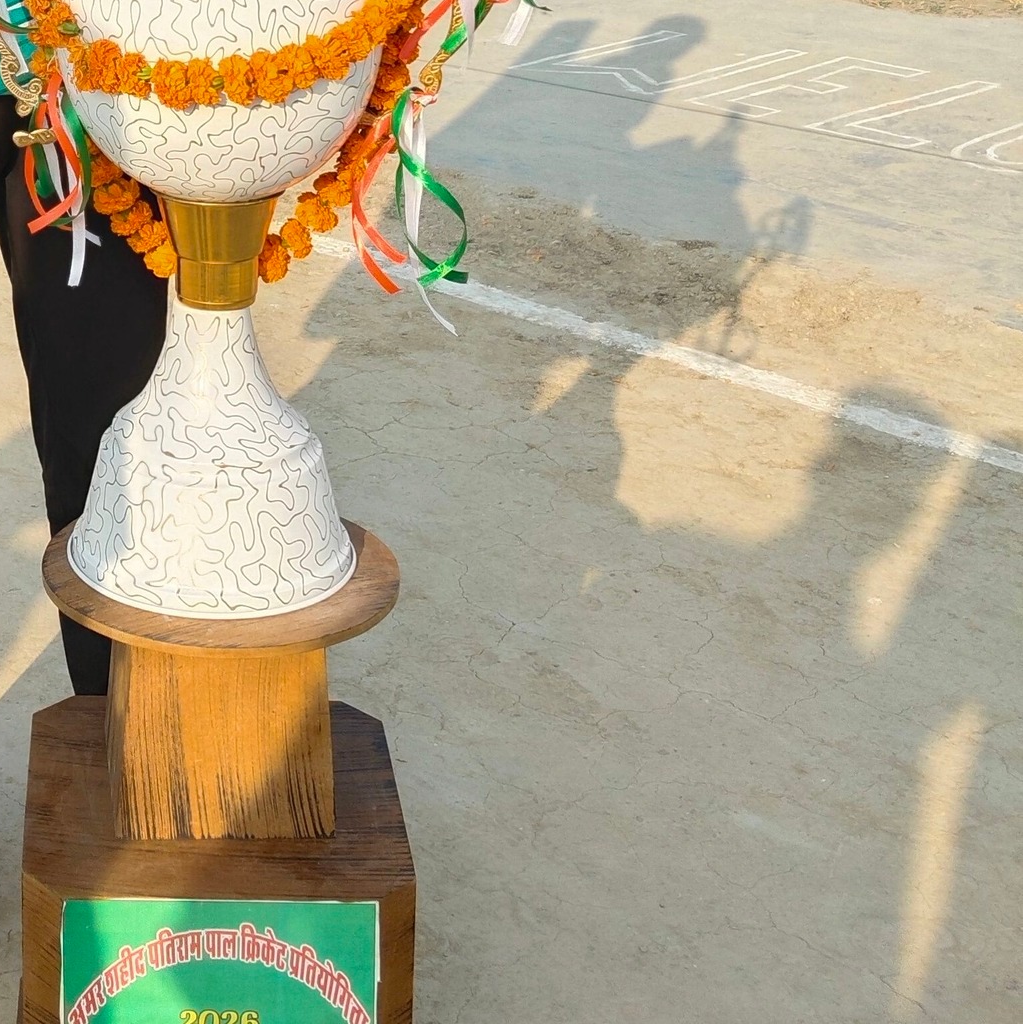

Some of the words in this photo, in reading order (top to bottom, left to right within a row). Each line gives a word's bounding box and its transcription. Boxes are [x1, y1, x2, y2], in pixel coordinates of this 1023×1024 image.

[103, 945, 147, 997] शहीद
[146, 927, 203, 971] पतिराम
[203, 929, 239, 961] पाल
[239, 922, 289, 972] क्रिकेट
